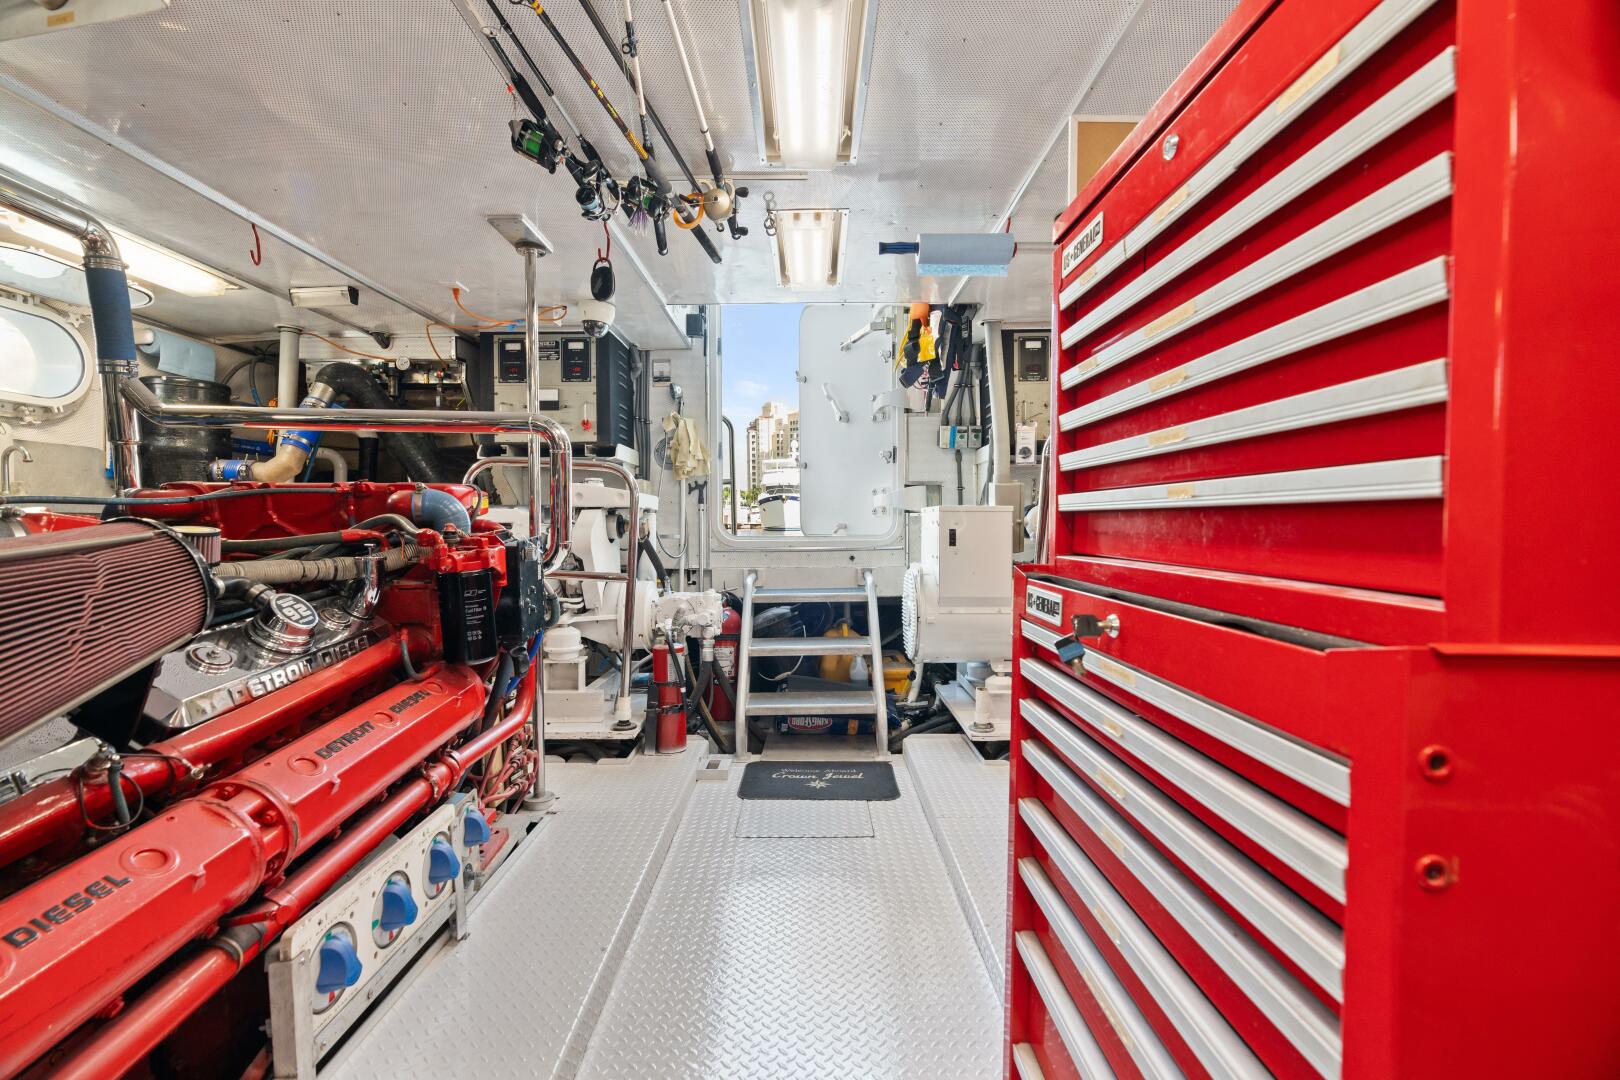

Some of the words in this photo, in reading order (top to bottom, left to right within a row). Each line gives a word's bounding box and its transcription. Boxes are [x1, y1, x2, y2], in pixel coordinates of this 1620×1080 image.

[282, 603, 313, 621] 92
[229, 656, 314, 705] DETROIT
[314, 721, 376, 760] DETROIT
[388, 689, 433, 715] DIESEL
[791, 716, 830, 727] KINGSFORD
[822, 772, 865, 780] Jewel
[2, 876, 132, 949] DIESEL
